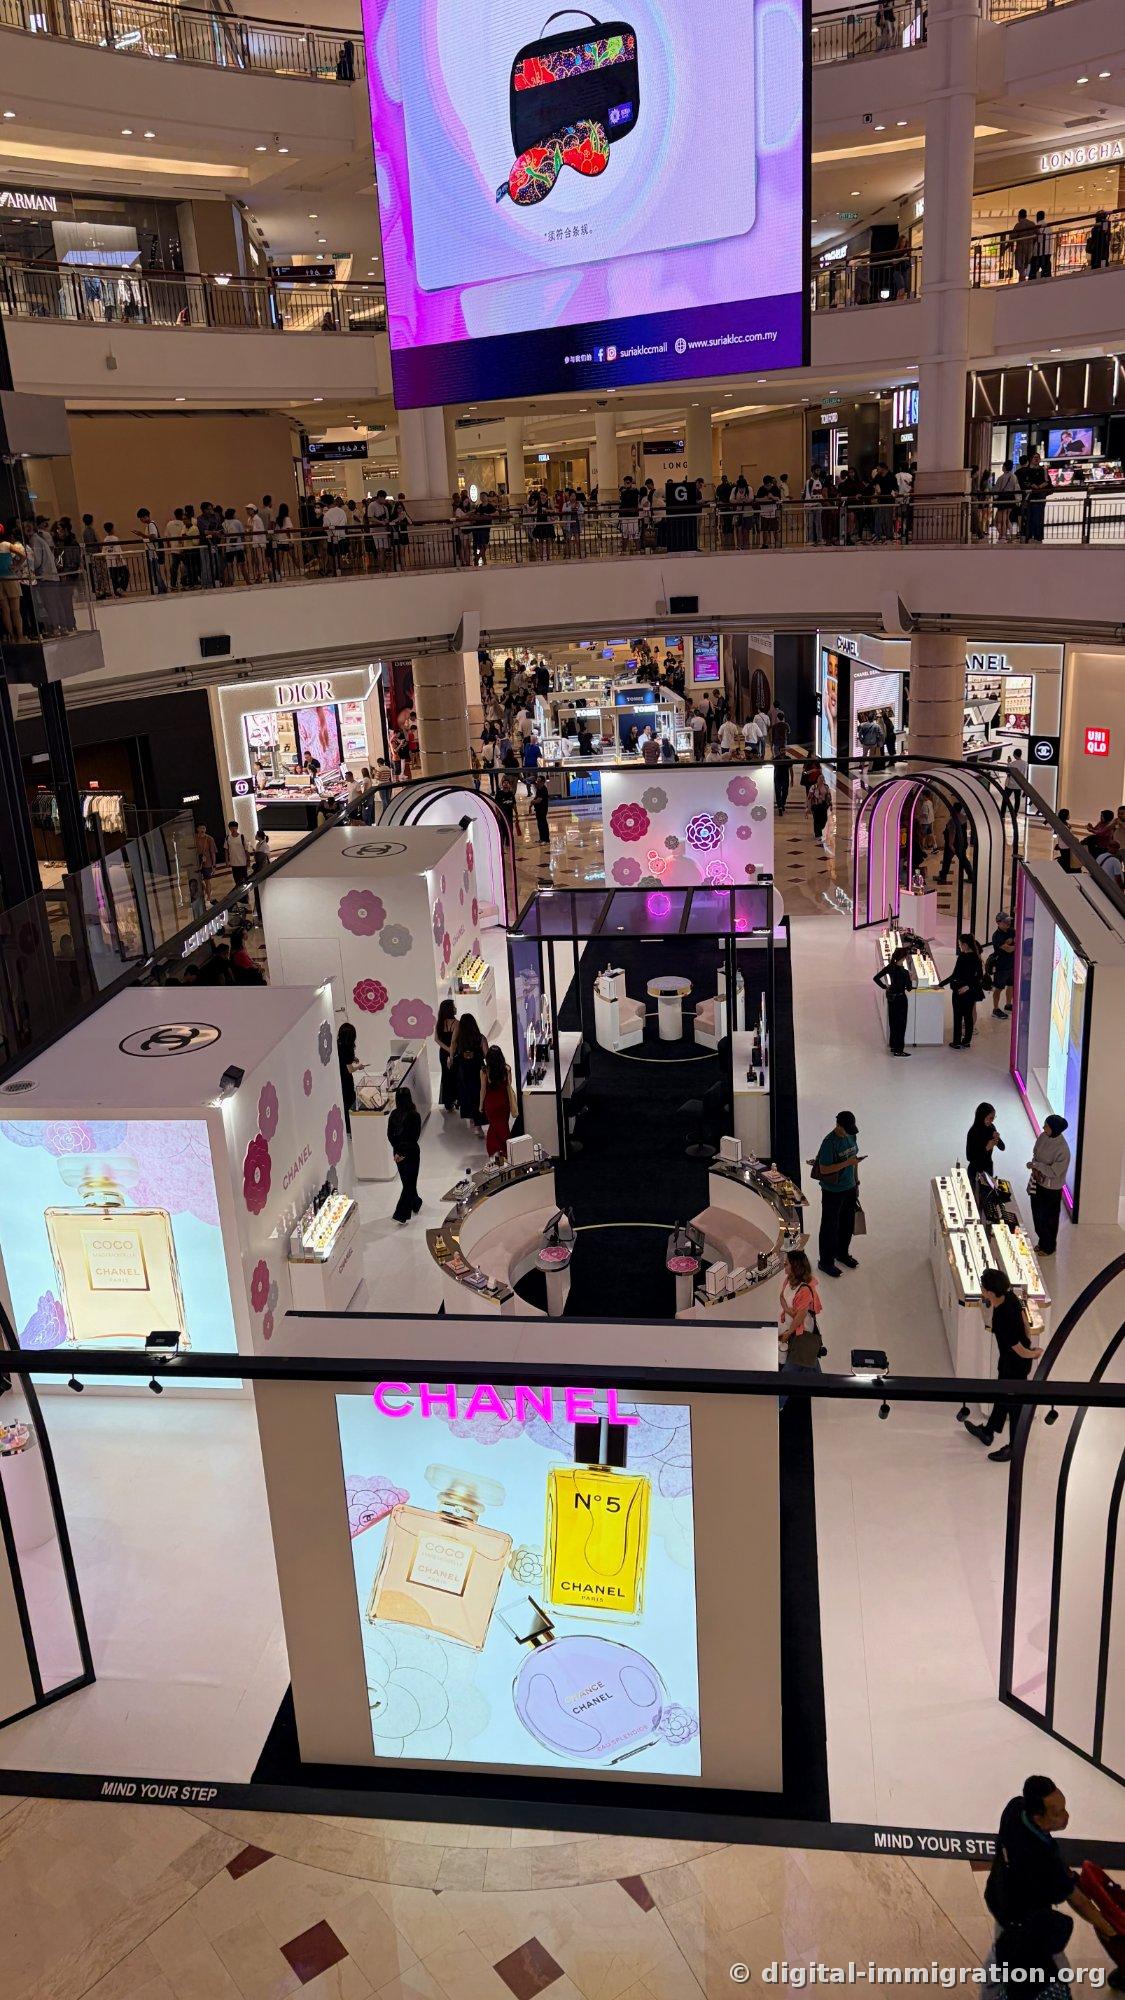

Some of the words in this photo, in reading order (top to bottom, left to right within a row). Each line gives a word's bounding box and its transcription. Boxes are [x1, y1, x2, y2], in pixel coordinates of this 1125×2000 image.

[7, 192, 58, 212] ARMANI
[688, 331, 778, 349] www.suriaklcc.com.my
[620, 344, 668, 358] suriaklccmall
[308, 444, 317, 453] G
[663, 462, 688, 470] LONG
[675, 486, 689, 502] G
[276, 681, 335, 707] DIOR
[1088, 731, 1106, 742] UNI
[1087, 742, 1107, 754] QLO
[282, 1143, 313, 1191] CHANEL
[92, 1240, 134, 1250] COCO
[95, 1267, 141, 1276] CHANEL
[373, 1381, 641, 1426] CHANEL
[574, 1492, 621, 1514] N°5
[425, 1542, 465, 1559] COCO
[417, 1565, 461, 1583] CHANEL
[561, 1581, 626, 1598] CHANEL
[581, 1595, 604, 1603] PARIS
[572, 1691, 614, 1714] CHANEL
[100, 1781, 137, 1797] MIND
[140, 1784, 179, 1799] YOUR
[180, 1786, 218, 1801] STEP
[874, 1832, 914, 1849] MIND
[917, 1835, 962, 1853] YOUR
[965, 1839, 996, 1855] STE
